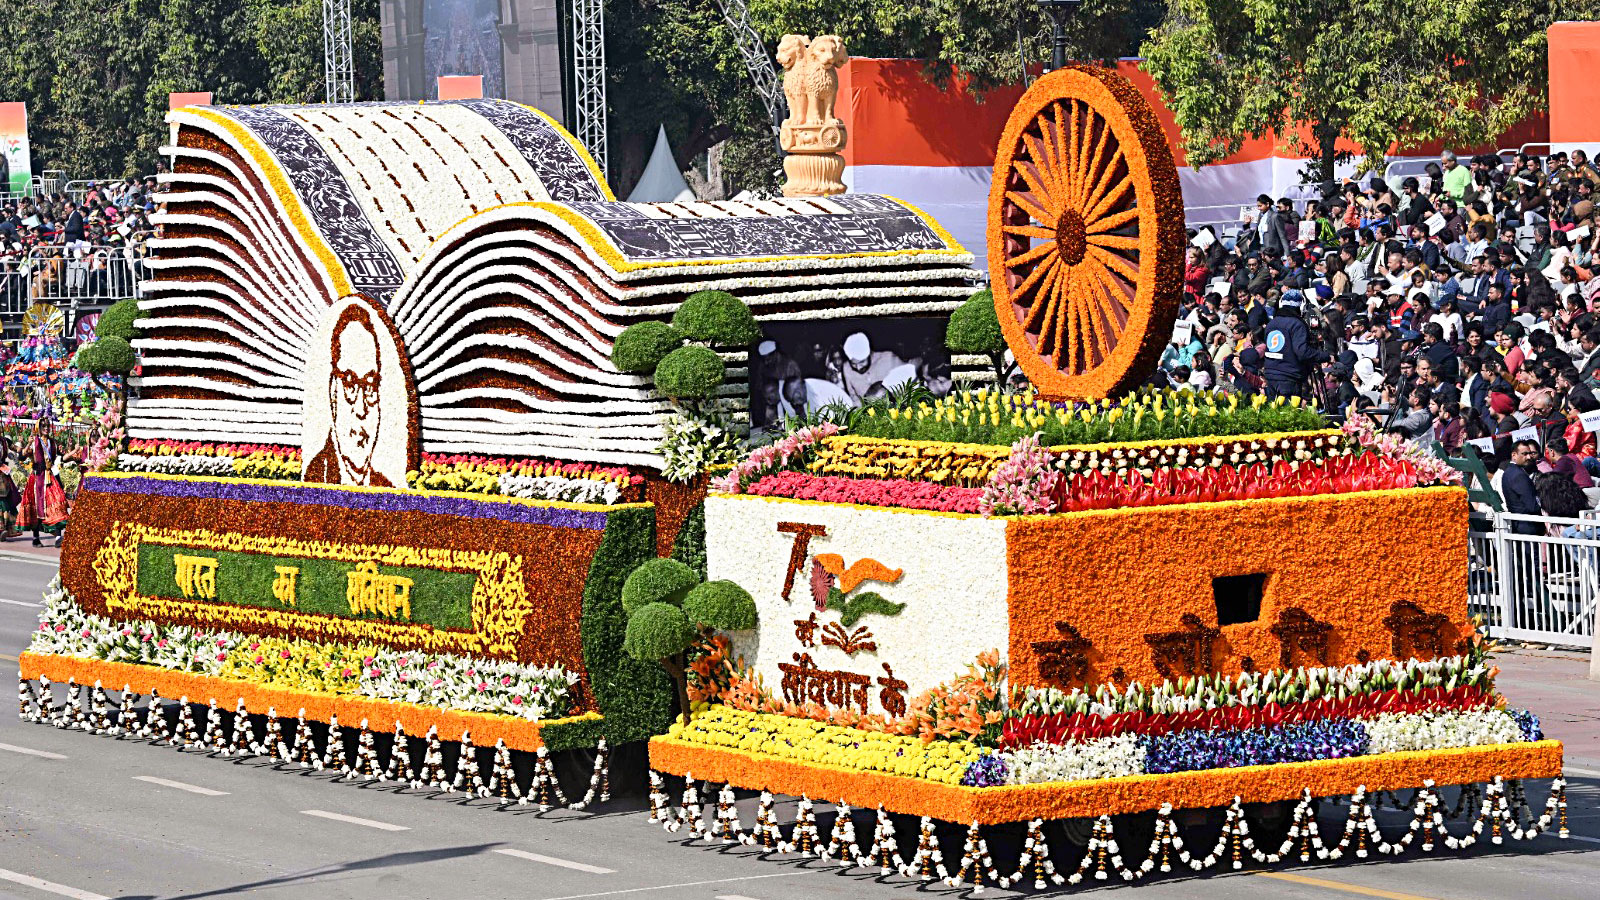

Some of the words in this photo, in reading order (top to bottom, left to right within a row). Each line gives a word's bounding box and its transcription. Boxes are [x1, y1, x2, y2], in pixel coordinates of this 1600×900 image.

[272, 565, 299, 606] का
[778, 652, 871, 715] संविधान
[877, 662, 908, 718] के
